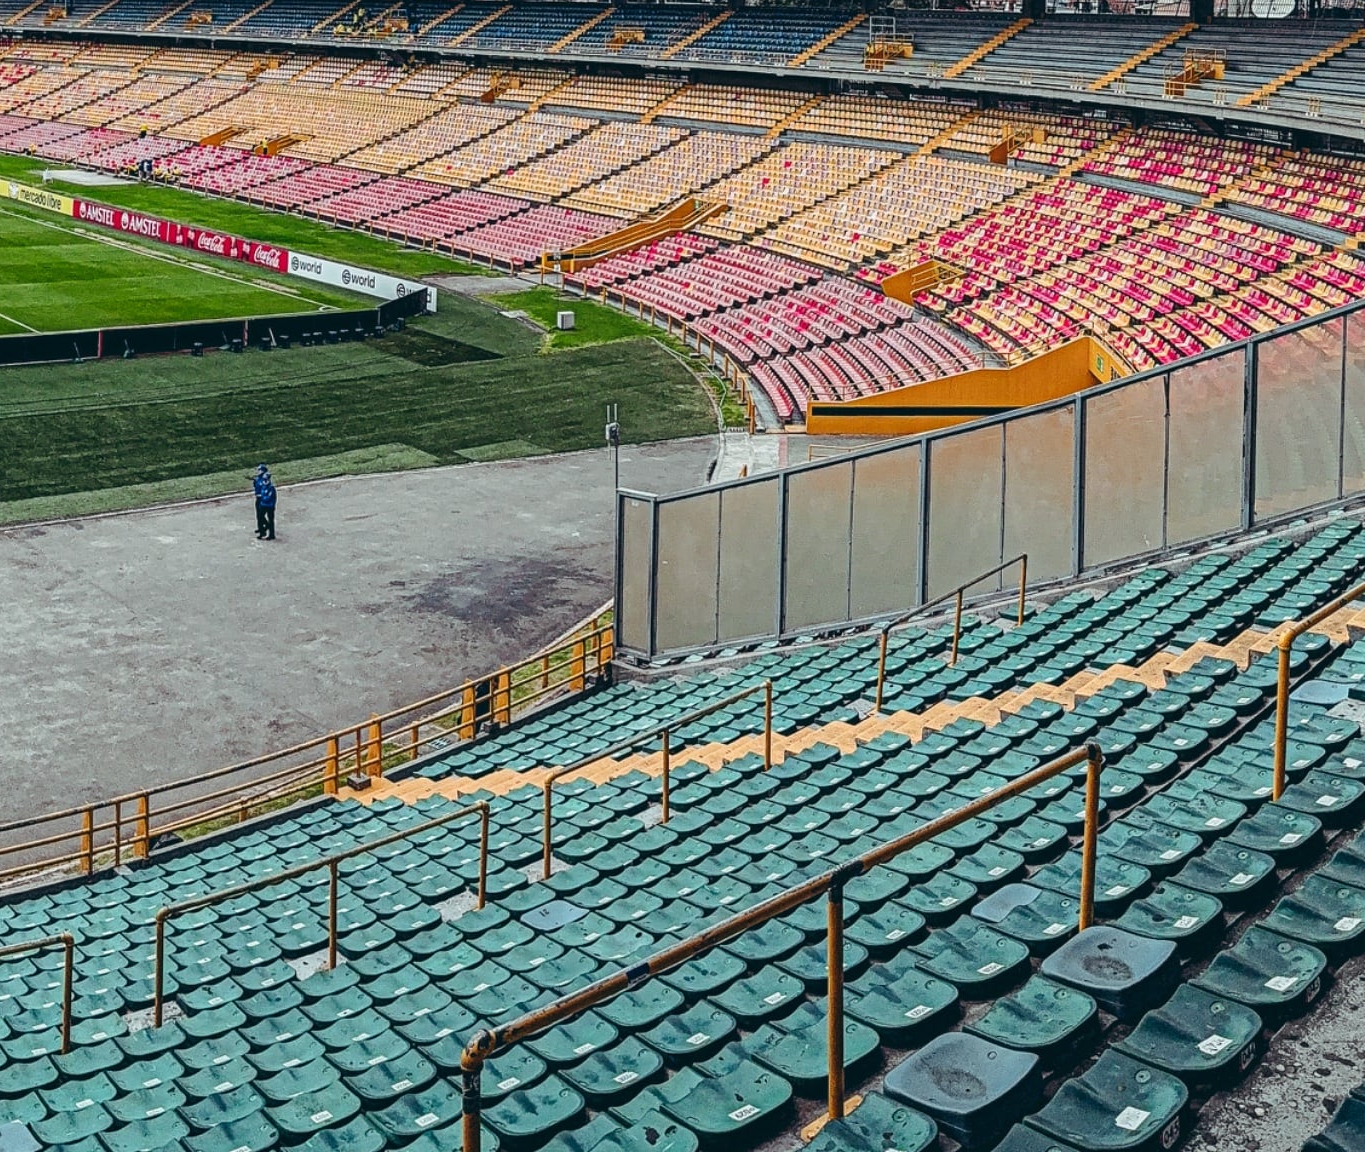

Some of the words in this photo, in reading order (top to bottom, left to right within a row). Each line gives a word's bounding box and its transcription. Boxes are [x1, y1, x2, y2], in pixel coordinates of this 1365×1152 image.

[20, 187, 47, 206] mercado
[47, 195, 62, 211] libre
[87, 204, 115, 227] AMSTEL
[128, 216, 161, 238] AMSTEL
[299, 259, 323, 276] world
[351, 271, 376, 289] world
